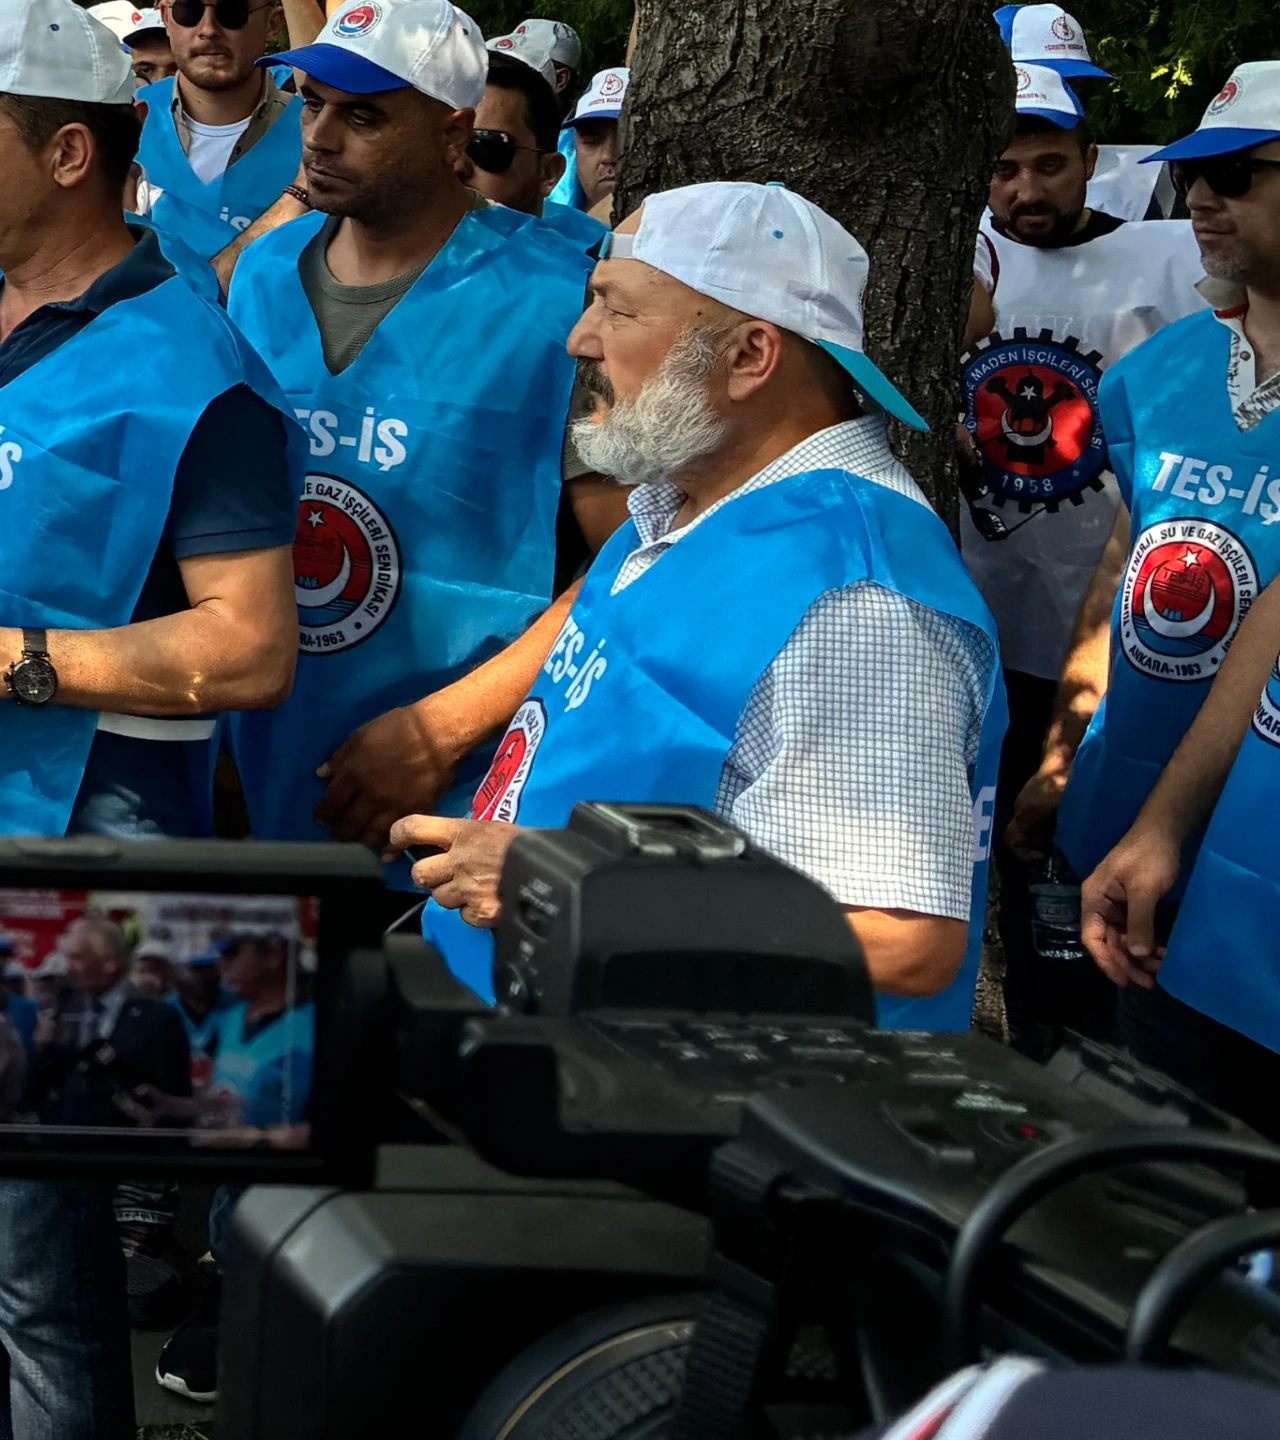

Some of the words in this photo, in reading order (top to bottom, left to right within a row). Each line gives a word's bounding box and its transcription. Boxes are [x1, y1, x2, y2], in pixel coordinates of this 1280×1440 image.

[971, 351, 1019, 381] MADEN
[1022, 347, 1085, 380] İŞÇİLERİ
[315, 482, 342, 502] GAZ
[1001, 473, 1054, 494] 1958
[341, 490, 390, 542] İŞÇİLERİ
[1160, 526, 1176, 541] SU
[1181, 525, 1196, 539] VE
[1197, 528, 1221, 546] GAZ
[1218, 537, 1253, 587] İŞÇİLERİ
[363, 544, 394, 619] SENDİKASI
